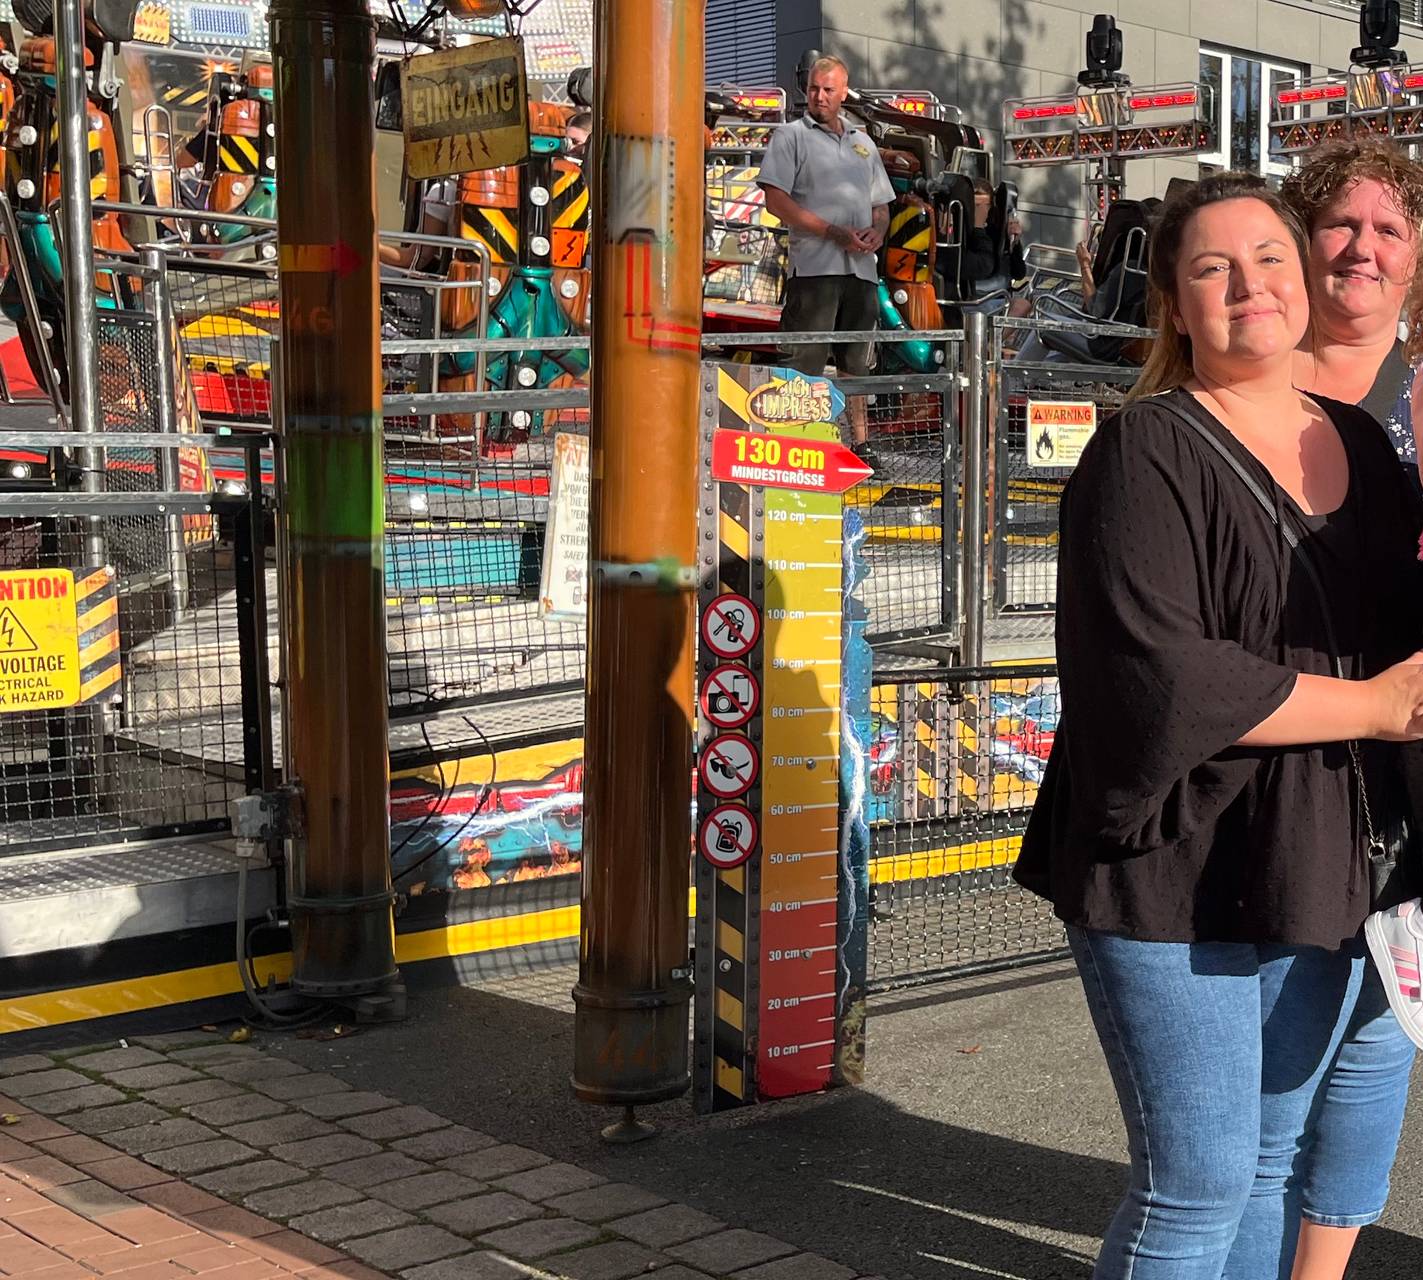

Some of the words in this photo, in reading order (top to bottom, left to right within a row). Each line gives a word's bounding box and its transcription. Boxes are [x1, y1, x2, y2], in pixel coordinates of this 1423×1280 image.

[412, 73, 515, 128] EINGANG
[762, 393, 832, 421] IMPRESS
[1043, 408, 1091, 421] WARNING
[735, 436, 781, 465] 130
[788, 447, 825, 470] cm
[731, 465, 825, 487] MINDESTGRÖSSE
[767, 510, 787, 521] 120
[789, 511, 806, 522] cm
[767, 560, 787, 570] 110
[789, 560, 806, 570] cm
[767, 609, 786, 619] 100
[789, 610, 805, 619] cm
[0, 655, 66, 675] VOLTAGE
[772, 658, 786, 669] 90
[788, 659, 804, 668] cm
[11, 689, 64, 705] HAZARD
[772, 707, 785, 718] 80
[788, 708, 804, 717] cm
[772, 756, 785, 766] 70
[787, 757, 803, 766] cm
[770, 804, 784, 815] 60
[786, 805, 802, 814] cm
[770, 853, 783, 864] 50
[786, 854, 801, 862] cm
[769, 901, 783, 913] 40
[785, 901, 801, 911] cm
[768, 950, 782, 961] 30
[784, 949, 800, 959] cm
[767, 999, 781, 1010] 20
[783, 998, 800, 1008] cm
[767, 1046, 780, 1058] 10
[783, 1045, 799, 1055] cm
